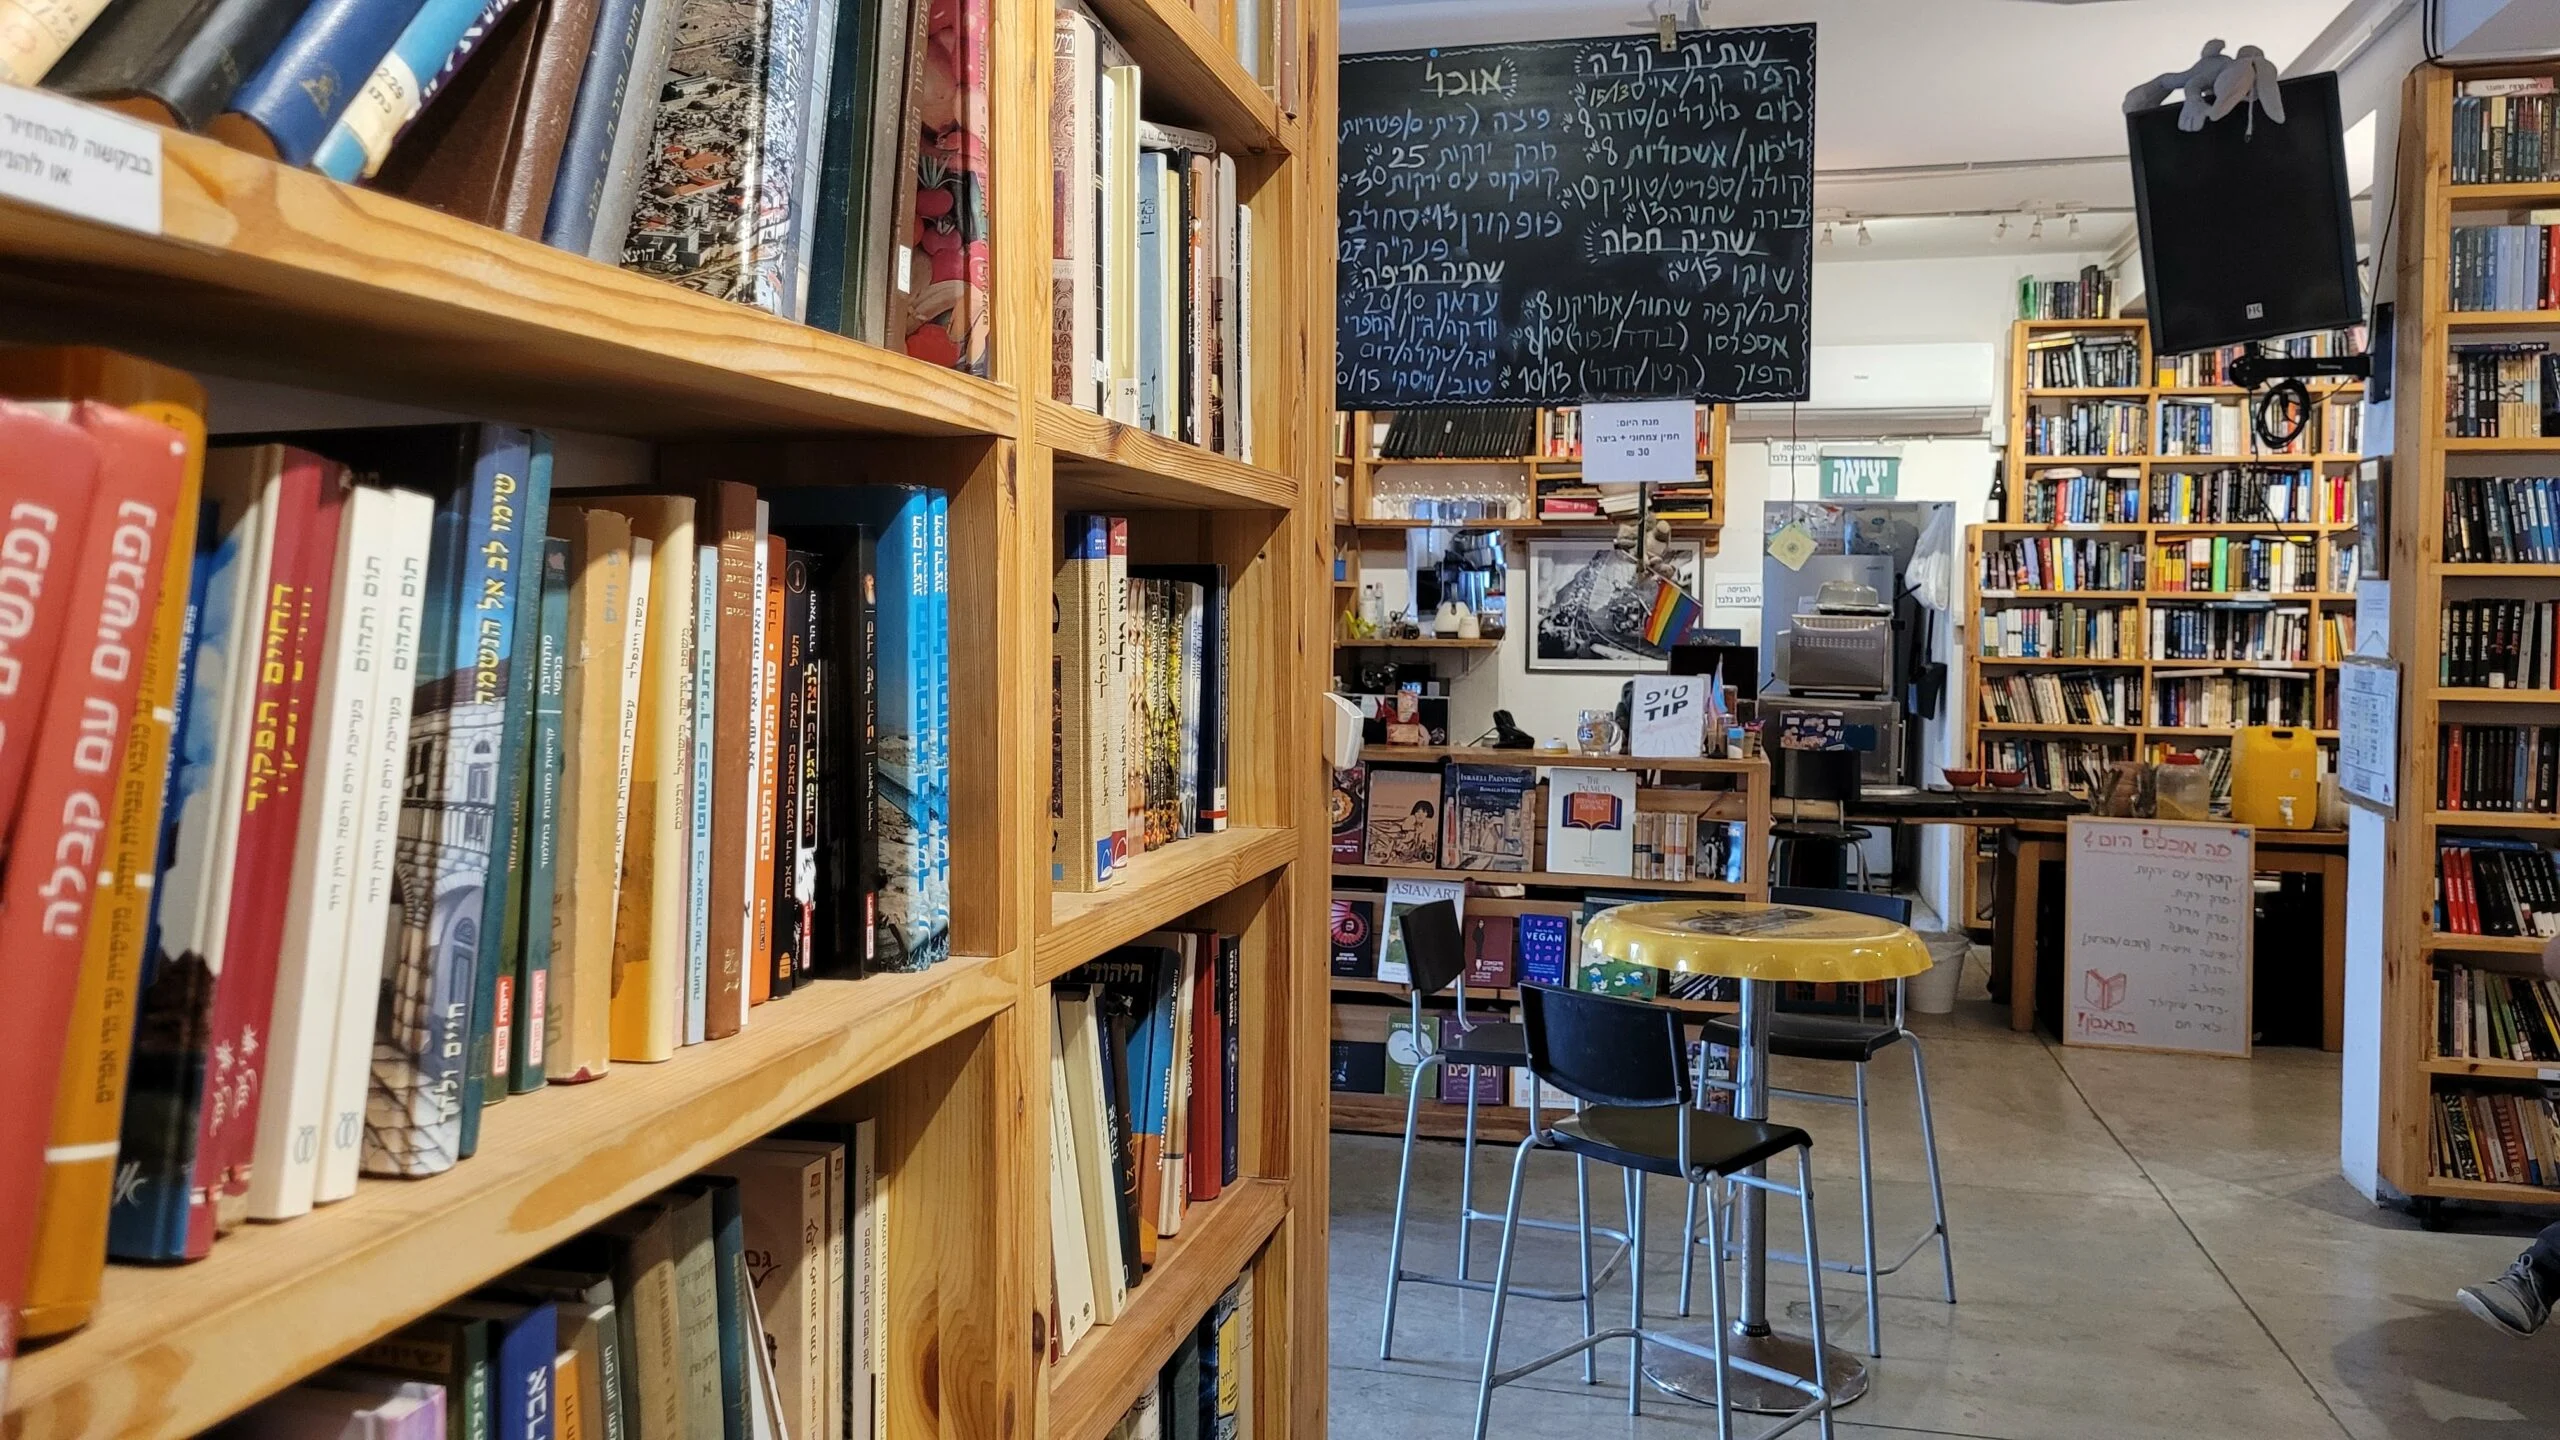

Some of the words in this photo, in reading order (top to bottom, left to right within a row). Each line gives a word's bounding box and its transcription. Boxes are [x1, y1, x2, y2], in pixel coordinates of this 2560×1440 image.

[1588, 42, 1653, 84] קלה
[1681, 40, 1767, 71] שתיה
[1425, 60, 1503, 98] אוכל
[1743, 66, 1801, 98] קפה
[1492, 108, 1550, 135] פיצה
[1577, 107, 1596, 139] 8
[1755, 95, 1804, 124] מים
[3, 112, 79, 152] להחזיר
[83, 138, 154, 176] בבקשה
[1388, 143, 1430, 169] 25
[1435, 141, 1493, 176] ירקות
[1514, 141, 1558, 170] מרק
[1601, 136, 1619, 167] 8
[49, 162, 73, 186] או
[1350, 165, 1388, 197] 30
[1385, 173, 1442, 202] ירקות
[1447, 171, 1479, 192] עם
[1488, 167, 1560, 203] קוסקוס
[1344, 200, 1420, 234] סחלב
[1461, 211, 1564, 250] פופקורן
[1669, 205, 1735, 225] שחורה
[1752, 208, 1810, 230] בירה
[1601, 223, 1663, 256] חמה
[1681, 228, 1757, 257] שתיה
[1361, 263, 1429, 291] חריפה
[1440, 260, 1505, 288] שתיה
[1732, 262, 1795, 298] שוקו
[1363, 286, 1426, 320] 20/10
[1435, 291, 1499, 320] עראק
[1536, 290, 1553, 320] 8
[1703, 294, 1799, 334] תה/קפה
[1706, 332, 1790, 361] אספרסו
[1734, 363, 1793, 394] הפוך
[1595, 433, 1617, 444] ביצה
[1616, 418, 1639, 428] היום:
[1628, 433, 1657, 443] צמחוני
[1642, 418, 1660, 427] מנת
[1660, 432, 1680, 443] חמין
[1638, 447, 1650, 457] 30
[1771, 454, 1792, 463] בלבד
[1831, 459, 1888, 494] יציאה
[491, 472, 517, 533] שימו
[911, 515, 924, 549] חיים
[934, 514, 945, 548] חיים
[481, 540, 510, 572] לב
[933, 551, 944, 594] הרצוג
[90, 499, 158, 682] נפגשים
[703, 575, 713, 605] יעקב
[754, 560, 764, 601] אבות
[912, 551, 924, 597] הרצוג
[476, 577, 507, 612] אל
[808, 590, 818, 622] יחיאל
[633, 597, 645, 628] משה
[767, 601, 779, 632] ובר
[1096, 580, 1107, 646] מקדש
[1151, 603, 1159, 623] בגן
[262, 583, 294, 686] החיים
[679, 627, 690, 667] משפט
[752, 607, 763, 660] האומה
[808, 624, 818, 653] הררי
[1150, 624, 1159, 668] האמונה
[474, 618, 503, 707] הנשמה
[543, 634, 554, 695] מתחייבת
[626, 632, 641, 679] ויינפלד
[788, 634, 800, 667] השל
[1160, 636, 1168, 681] האמונה
[553, 655, 564, 697] בנפשי
[751, 666, 761, 713] ונביאי
[765, 660, 777, 700] סוד
[803, 661, 819, 715] לנצח
[863, 665, 874, 695] של
[1094, 653, 1108, 699] מלך
[788, 692, 799, 729] קוצק
[1644, 684, 1689, 706] טיפ
[1644, 700, 1689, 722] TIP
[73, 697, 119, 775] עם
[346, 699, 364, 764] בעריכת
[385, 696, 402, 762] בעריכת
[622, 699, 635, 740] עשרת
[805, 722, 817, 744] כל
[865, 699, 876, 745] הרבי
[246, 700, 281, 813] תפקיד
[544, 727, 556, 771] קריאות
[761, 704, 777, 786] הנקודה
[1100, 732, 1109, 762] יגאל
[341, 766, 355, 796] יורם
[381, 758, 395, 790] יורם
[786, 743, 798, 795] במאבק
[866, 762, 874, 798] יחיאל
[1460, 773, 1488, 783] ISRAELI
[1488, 774, 1523, 785] PAINTING
[696, 742, 709, 838] כפשוטו
[1100, 765, 1109, 807] אריאל
[759, 789, 774, 861] הטובה
[784, 799, 796, 835] למען
[538, 824, 551, 868] בתלמוד
[2204, 842, 2232, 857] מה
[38, 789, 106, 938] קבלה
[2171, 868, 2191, 880] עם
[328, 882, 342, 911] דוד
[366, 876, 382, 904] דוד
[783, 865, 794, 899] אמת
[1391, 883, 1432, 899] ASIAN
[1433, 886, 1460, 901] ART
[1526, 931, 1562, 943] VEGAN
[443, 1001, 466, 1058] חיים
[810, 1288, 818, 1321] כתוב
[860, 1273, 872, 1306] שלום
[862, 1309, 871, 1346] מבשר
[862, 1348, 870, 1371] טוב
